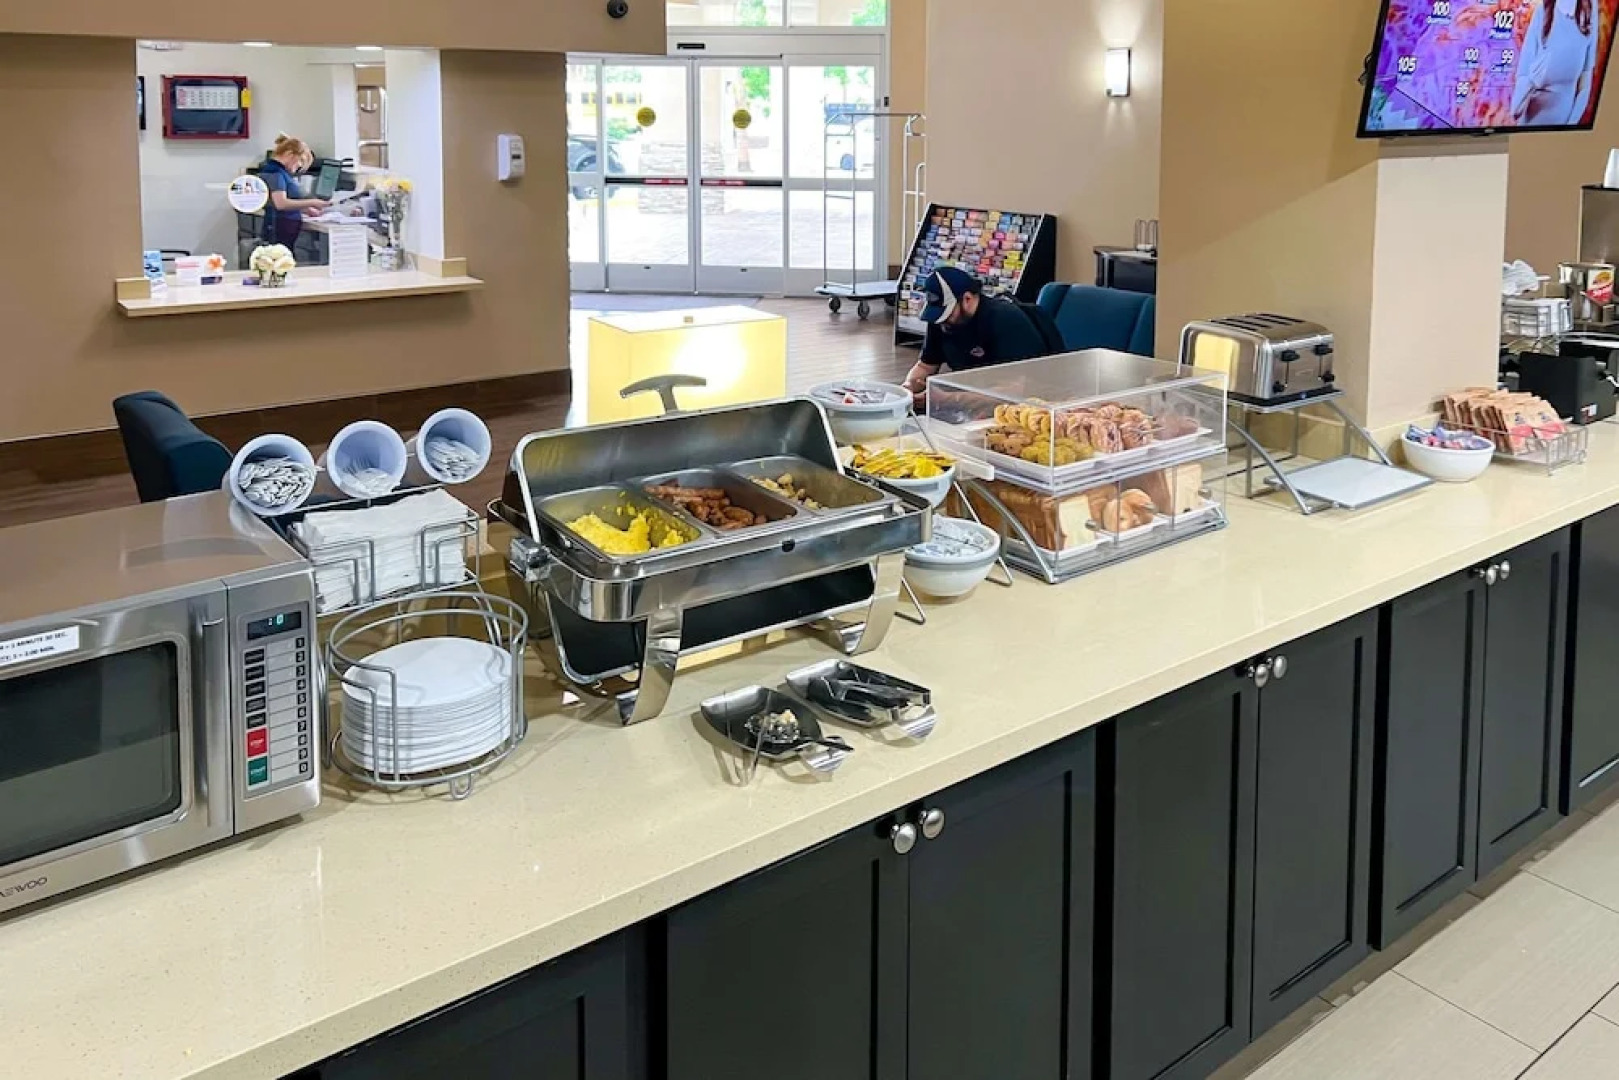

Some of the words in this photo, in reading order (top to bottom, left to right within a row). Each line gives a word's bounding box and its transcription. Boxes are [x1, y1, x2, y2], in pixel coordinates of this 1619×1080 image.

[1433, 1, 1450, 16] 100
[1494, 10, 1514, 28] 102
[1398, 56, 1417, 72] 105
